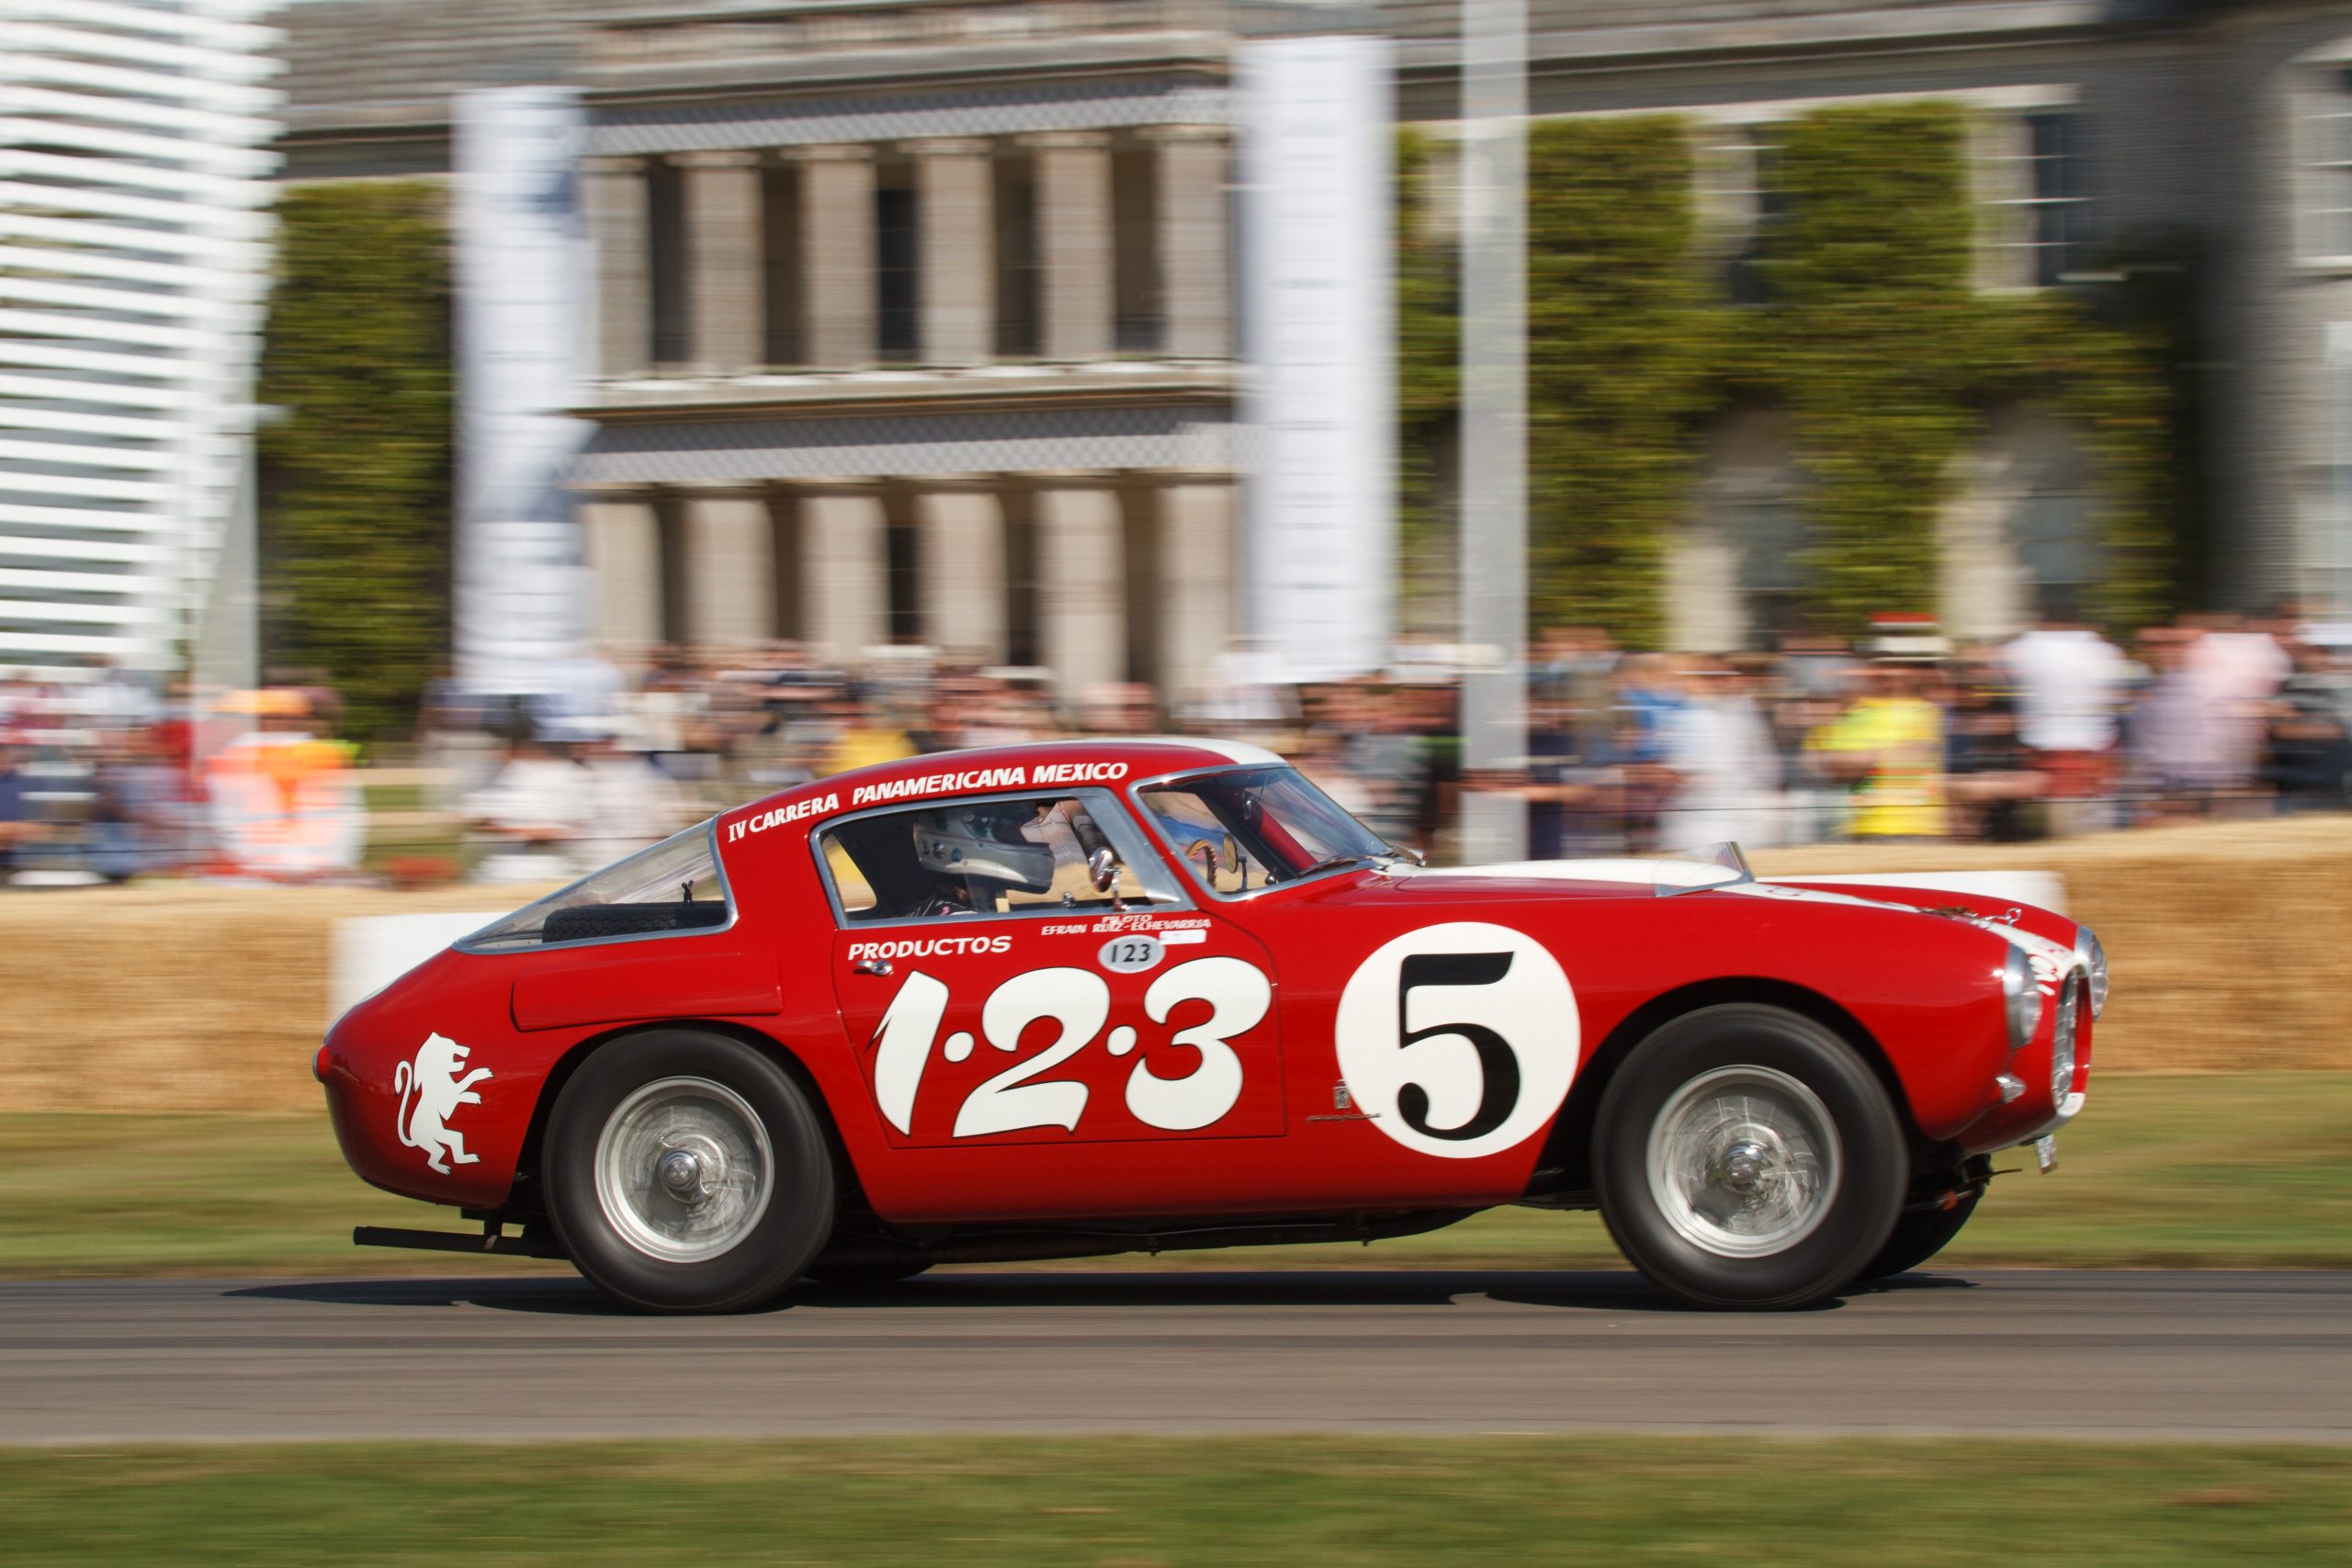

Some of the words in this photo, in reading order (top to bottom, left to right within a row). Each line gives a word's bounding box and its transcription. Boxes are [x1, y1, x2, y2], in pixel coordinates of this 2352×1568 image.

[728, 819, 747, 842] IV
[750, 794, 839, 833] CARRERA
[853, 766, 1026, 804] PANAMERICANA
[1032, 762, 1129, 784] MEXICO
[1041, 923, 1088, 935] EFRAIN
[1102, 914, 1153, 924] PILOTO
[848, 935, 1012, 960] PRODUCTOS
[1111, 943, 1151, 964] 123
[1397, 950, 1521, 1141] 5
